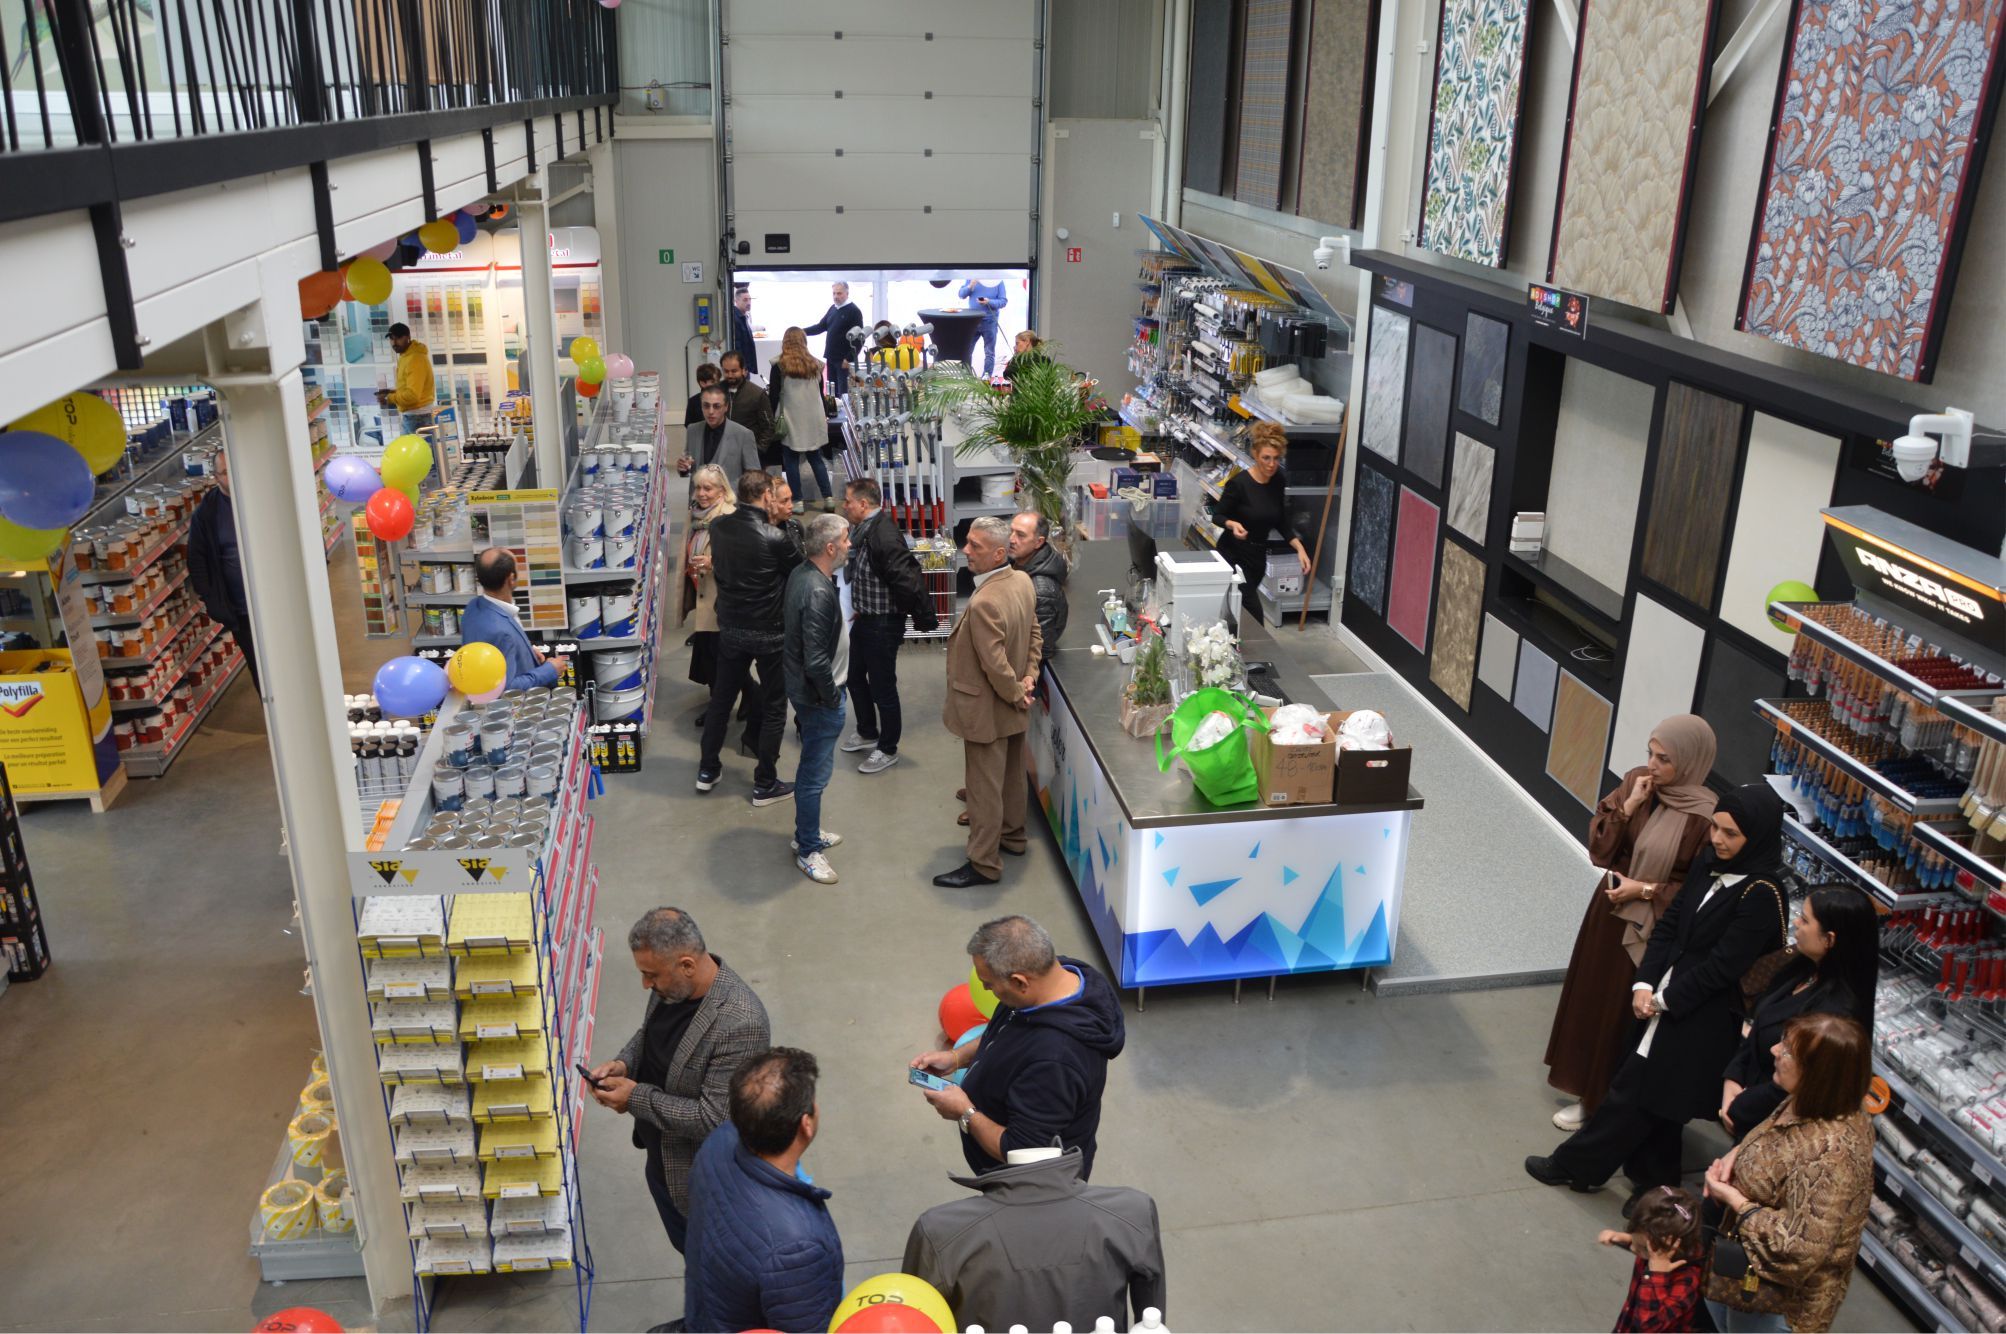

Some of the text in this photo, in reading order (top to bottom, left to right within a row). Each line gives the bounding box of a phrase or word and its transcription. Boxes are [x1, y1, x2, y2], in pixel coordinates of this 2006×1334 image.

[1855, 546, 1948, 604] ANZA
[371, 860, 400, 871] sia
[460, 858, 489, 869] sia
